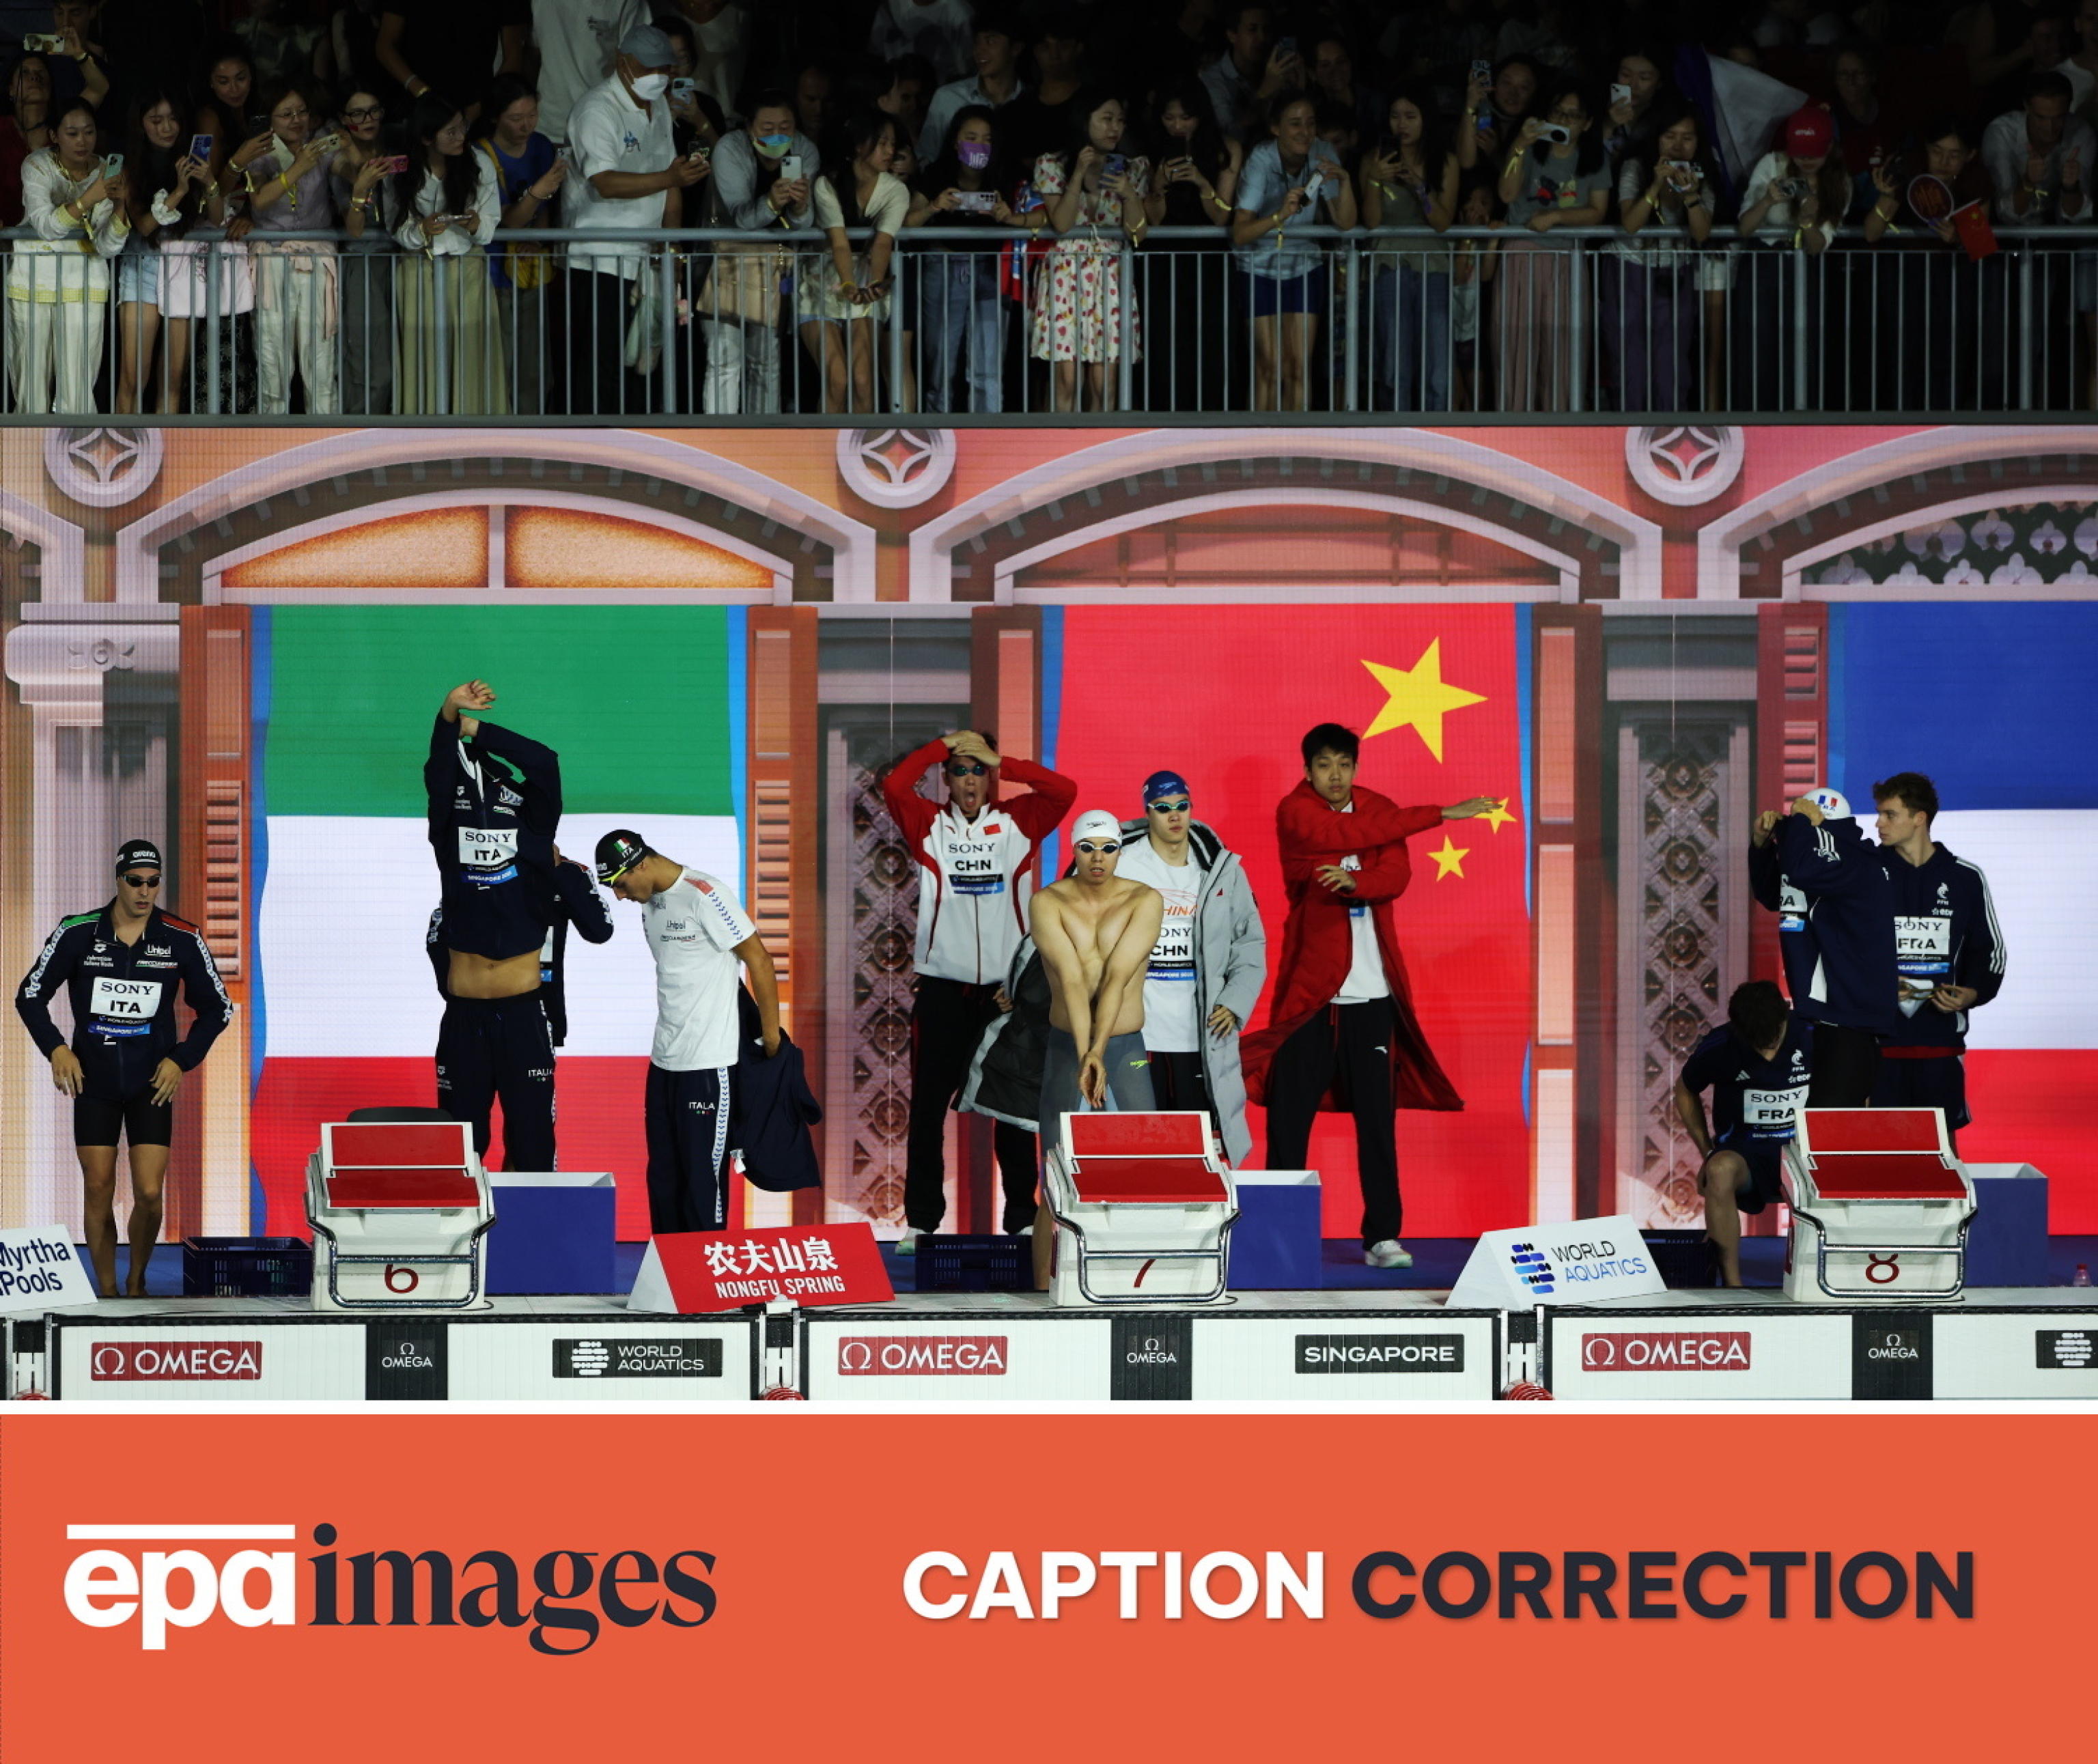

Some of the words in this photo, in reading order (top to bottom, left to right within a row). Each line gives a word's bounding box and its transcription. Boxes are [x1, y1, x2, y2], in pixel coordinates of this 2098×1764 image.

[465, 831, 511, 843] SONY
[475, 848, 501, 860] ITA
[949, 843, 995, 854] SONY
[955, 860, 992, 871] CHN
[1894, 921, 1942, 931] SONY
[1160, 927, 1192, 938] ONY
[1898, 938, 1937, 949] FRA
[1151, 945, 1188, 956] CHN
[101, 981, 154, 996] SONY
[110, 1000, 141, 1013] ITA
[1750, 1090, 1803, 1104] SONY
[1758, 1108, 1795, 1120] FRA
[703, 1236, 839, 1276] 农夫山泉
[1551, 1240, 1616, 1262] WORLD
[1565, 1257, 1647, 1283] AQUATICS
[1865, 1253, 1900, 1284] 8
[384, 1263, 419, 1293] 6
[714, 1278, 779, 1298] NONGFU
[785, 1275, 845, 1295] SPRING
[617, 1345, 682, 1357] WORLD
[881, 1343, 1004, 1369] OMEGA
[1304, 1346, 1455, 1362] SINGAPORE
[1625, 1339, 1748, 1365] OMEGA
[1868, 1348, 1918, 1359] OMEGA
[135, 1348, 258, 1375] OMEGA
[381, 1357, 433, 1368] OMEGA
[1126, 1352, 1177, 1364] OMEGA
[617, 1359, 704, 1371] AQUATICS
